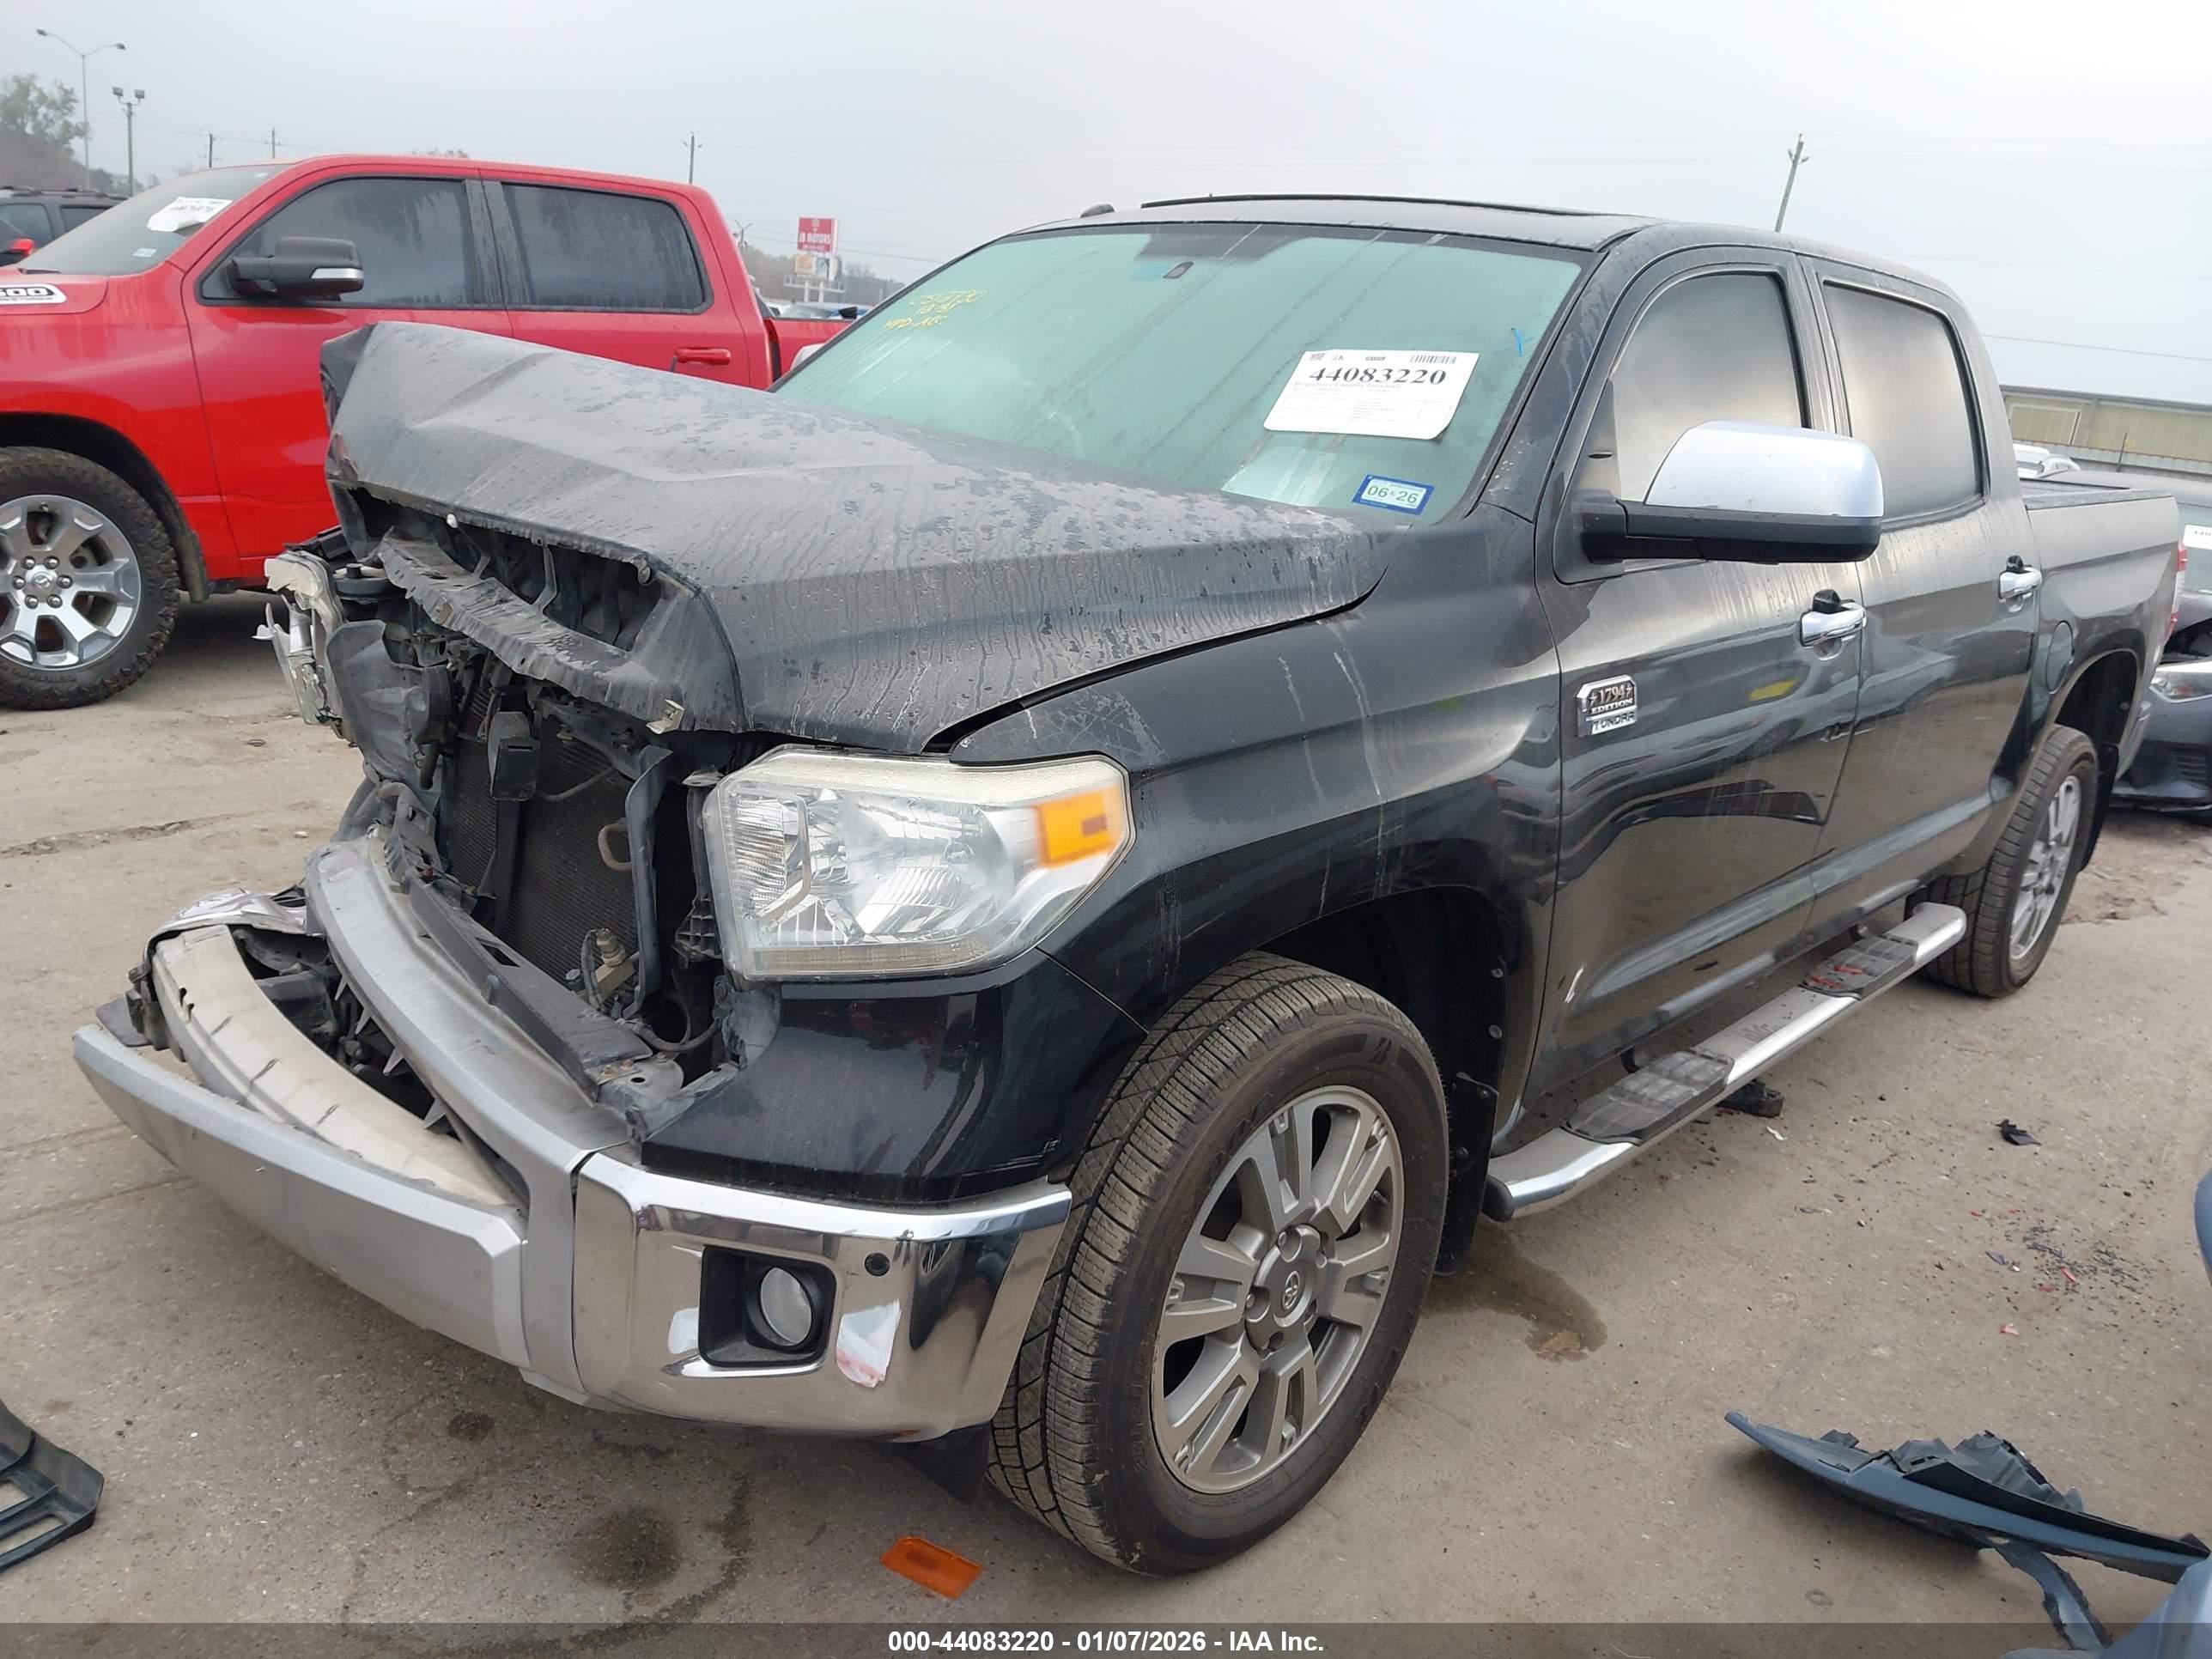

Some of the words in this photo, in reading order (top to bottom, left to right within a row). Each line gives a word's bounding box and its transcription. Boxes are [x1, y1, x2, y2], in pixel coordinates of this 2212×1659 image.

[1310, 367, 1447, 385] 44083220
[1367, 485, 1390, 498] 06
[1395, 489, 1419, 503] 26
[1599, 684, 1626, 704] 1794
[1591, 699, 1632, 714] EDITION
[1593, 712, 1634, 730] TUNDRA
